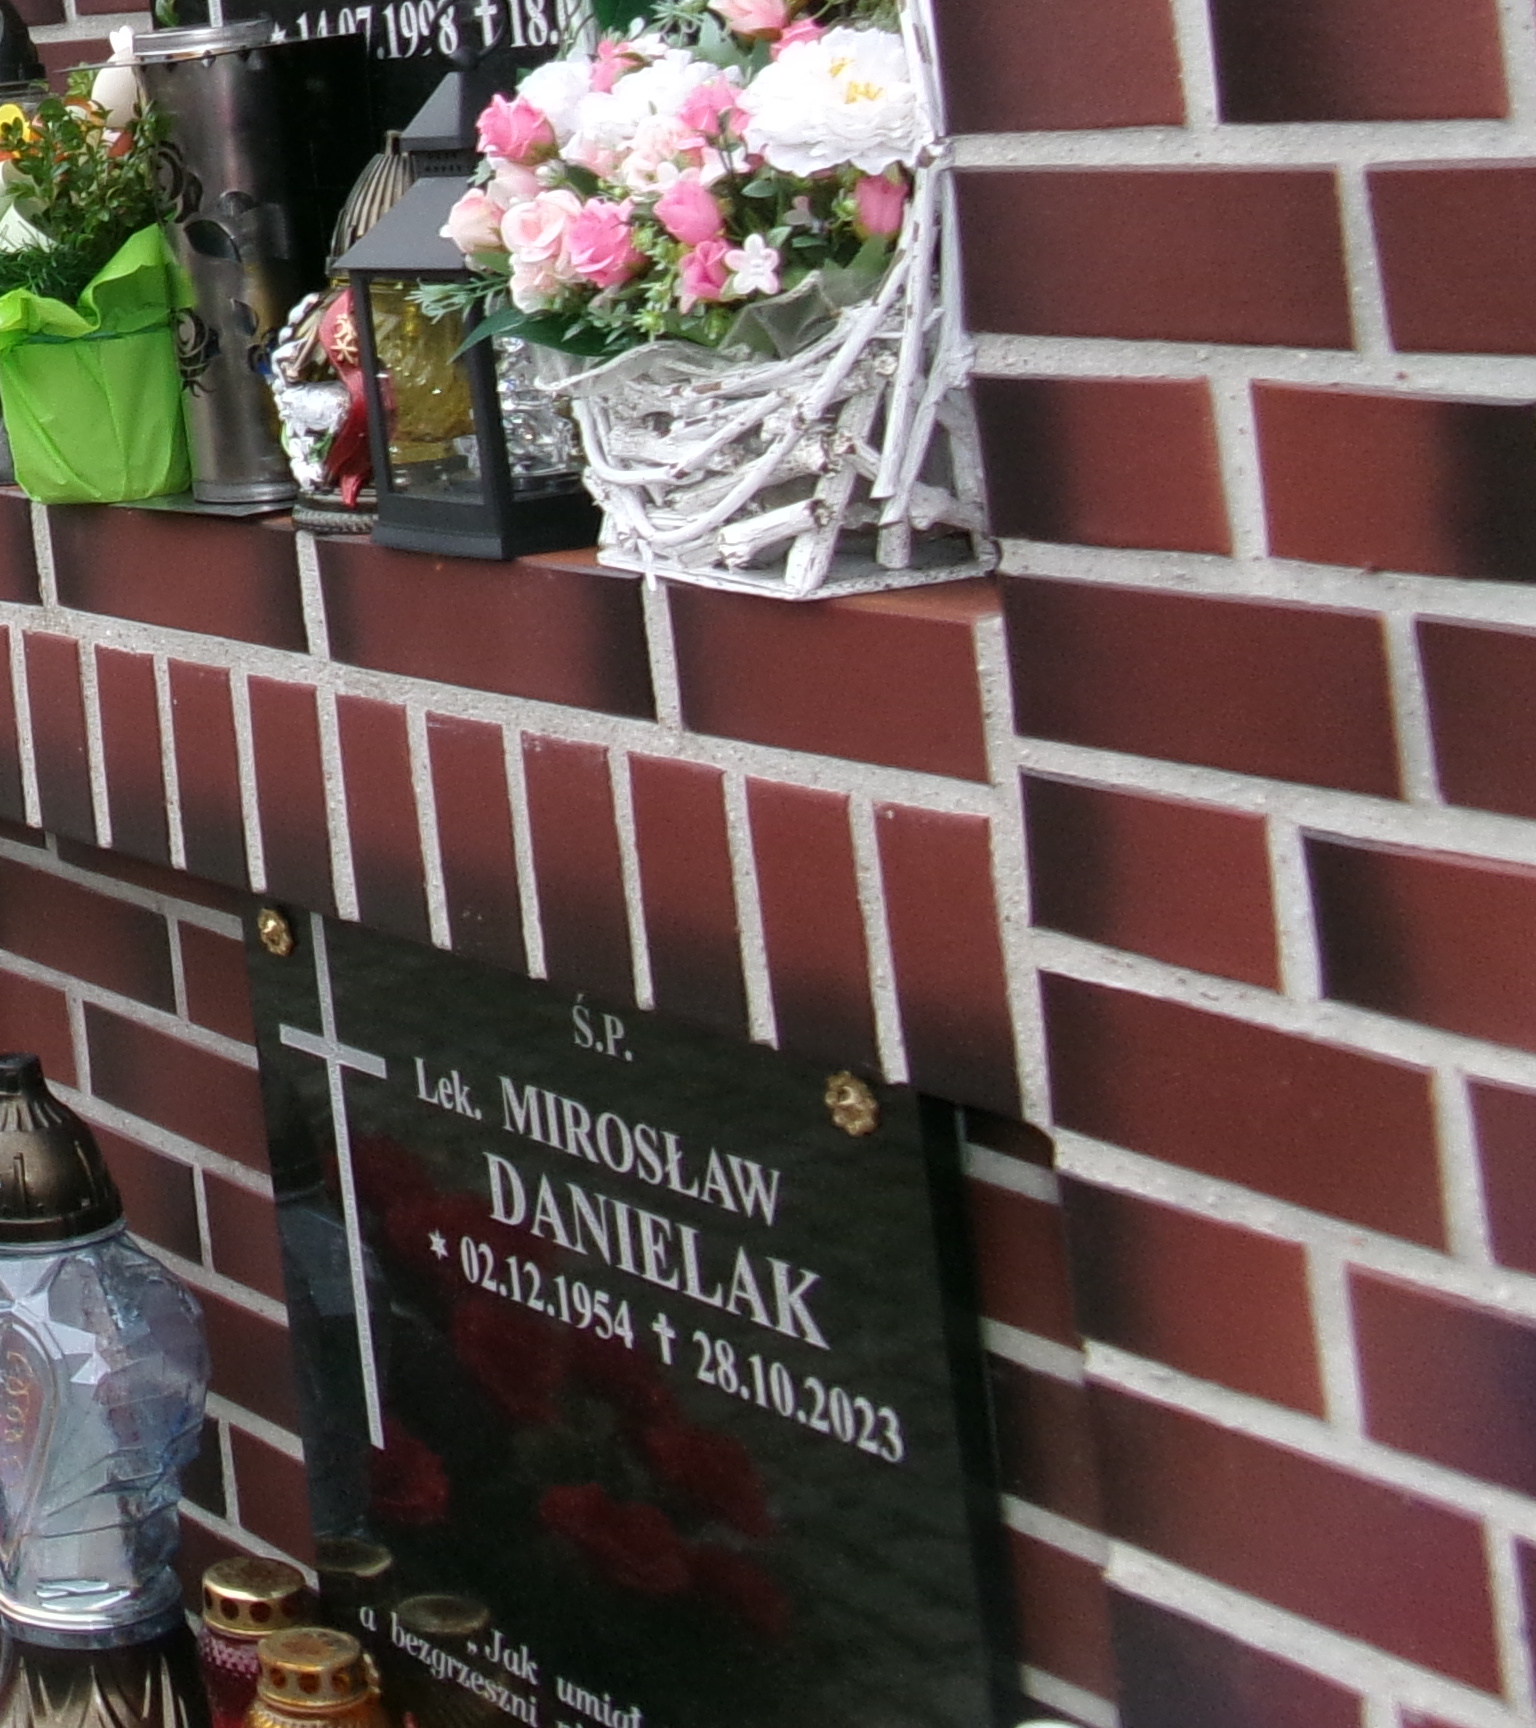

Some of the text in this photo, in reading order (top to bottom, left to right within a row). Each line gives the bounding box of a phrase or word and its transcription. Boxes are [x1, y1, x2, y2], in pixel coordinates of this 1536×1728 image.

[571, 993, 634, 1062] Ś.P.
[413, 1055, 781, 1228] Lek. MIROSŁAW
[483, 1150, 832, 1351] DANIELAK
[459, 1235, 905, 1466] 02.12.1954 28.10.2023
[358, 1605, 538, 1728] a bezgrzeszni
